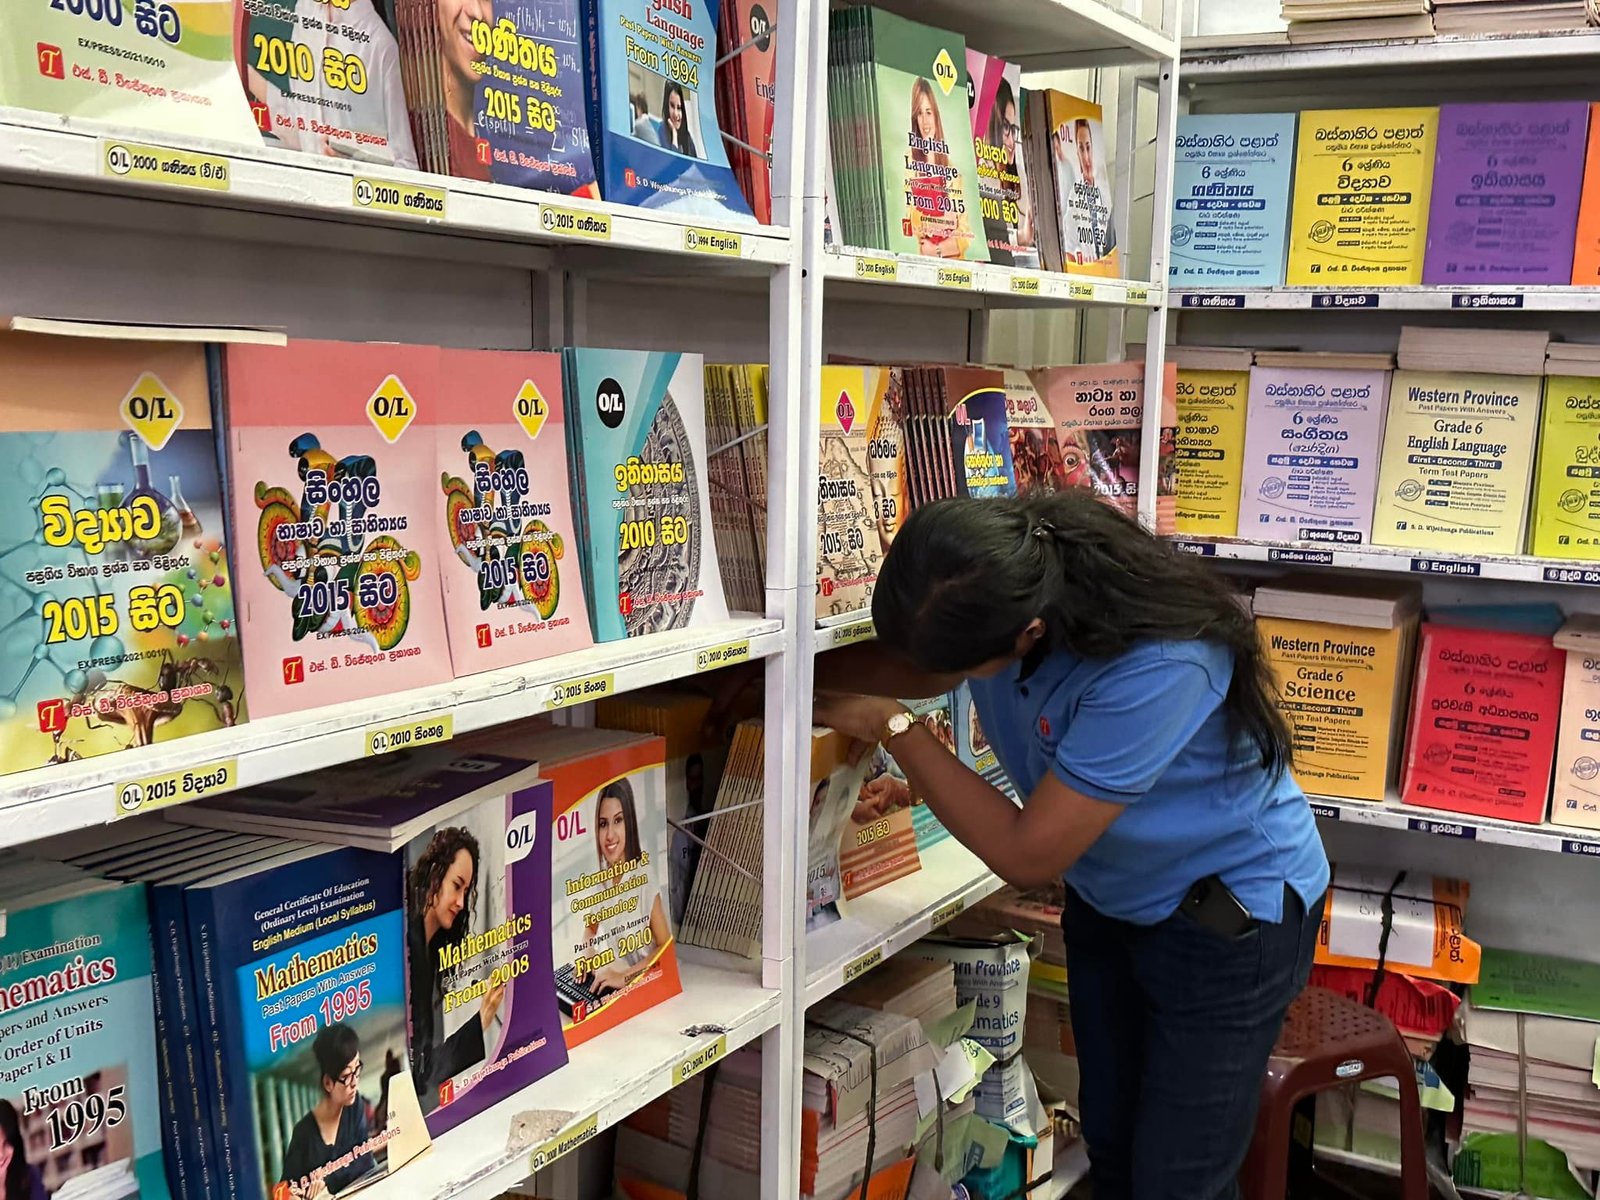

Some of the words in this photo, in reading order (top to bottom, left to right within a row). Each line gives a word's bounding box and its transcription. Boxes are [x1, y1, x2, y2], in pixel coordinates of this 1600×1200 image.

[646, 8, 704, 49] Language
[470, 18, 557, 78] ගණිතය
[254, 34, 314, 82] 2010
[323, 47, 367, 94] සිට
[626, 36, 658, 71] From
[662, 51, 698, 89] 1994
[484, 87, 521, 124] 2015
[527, 97, 556, 132] සිට
[908, 132, 949, 154] English
[1240, 133, 1279, 149] පළාත්
[1316, 126, 1378, 141] බස්නාහිර
[1383, 124, 1424, 140] පළාත්
[134, 156, 157, 171] 2000
[162, 159, 196, 176] ගණිතය
[904, 155, 958, 180] Language
[1202, 166, 1211, 178] 6
[1342, 158, 1353, 171] 6
[1191, 183, 1255, 197] ගණිතය
[1337, 175, 1391, 191] විද්‍යාව
[1471, 171, 1546, 189] ඉතිහාසය
[376, 187, 399, 204] 2010
[404, 194, 443, 211] ගණිතය
[905, 191, 934, 209] From
[938, 197, 965, 214] 2015
[557, 214, 574, 229] 2015
[577, 219, 607, 233] ගණිතය
[710, 237, 738, 250] English
[874, 264, 895, 276] English
[1203, 297, 1236, 307] ගණිතය
[1335, 296, 1366, 307] විද්‍යාව
[1472, 295, 1516, 307] ඉතිහාසය
[1075, 388, 1113, 404] නාට්‍ය
[1120, 389, 1136, 402] හා
[1200, 383, 1237, 396] පළාත්
[1265, 383, 1325, 397] බස්නාහිර
[1331, 385, 1371, 399] පළාත්
[1408, 387, 1459, 403] Western
[1463, 390, 1519, 407] Province
[129, 397, 173, 421] O/L
[373, 396, 408, 419] O/L
[518, 399, 543, 417] O/L
[598, 393, 623, 413] O/L
[1088, 405, 1115, 417] රංග
[1293, 410, 1303, 425] 6
[1434, 420, 1472, 434] Grade
[1475, 421, 1483, 434] 6
[1281, 427, 1348, 441] සංගීතය
[869, 439, 897, 459] ධර්මය
[1407, 435, 1449, 454] English
[1452, 438, 1507, 458] Language
[1412, 456, 1431, 464] First
[1437, 457, 1467, 466] Second
[1474, 459, 1496, 468] Third
[1419, 467, 1440, 476] Term
[1442, 468, 1458, 477] Test
[1460, 469, 1488, 480] Papers
[475, 462, 529, 495] සිංහල
[614, 456, 683, 492] ඉතිහාසය
[305, 470, 380, 508] සිංහල
[460, 504, 492, 524] භාෂාව
[495, 506, 507, 520] හා
[511, 501, 551, 519] සාහිත්‍යය
[40, 494, 162, 555] විද්‍යාව
[276, 519, 324, 542] භාෂාව
[329, 521, 346, 538] හා
[351, 513, 408, 535] සාහිත්‍යය
[620, 520, 656, 551] 2010
[660, 516, 688, 546] සිට
[821, 531, 841, 555] 2015
[847, 528, 864, 551] සිට
[25, 569, 63, 585] පසුගිය
[67, 563, 98, 579] විභාග
[102, 561, 129, 578] ප්‍රශ්න
[132, 560, 150, 574] සහ
[153, 554, 190, 571] පිළිතුරු
[481, 557, 516, 591] 2015
[522, 552, 550, 583] සිට
[1431, 563, 1474, 574] English
[299, 578, 350, 618] 2015
[358, 571, 398, 609] සිට
[43, 593, 119, 645] 2015
[129, 583, 186, 633] සිට
[723, 646, 748, 661] ඉතිහාසය
[1271, 635, 1319, 653] Western
[1323, 639, 1376, 657] Province
[1297, 667, 1333, 682] Grade
[1336, 670, 1343, 682] 6
[566, 684, 581, 698] 2015
[584, 679, 606, 693] සිංහල
[1285, 681, 1355, 701] Science
[1302, 704, 1331, 713] Second
[1337, 706, 1357, 716] Third
[1324, 715, 1350, 726] Papers
[390, 730, 411, 747] 2010
[414, 723, 444, 741] සිංහල
[146, 779, 176, 802] 2015
[182, 768, 228, 793] විද්‍යාව
[506, 824, 533, 849] O/L
[557, 811, 587, 841] O/L
[857, 827, 875, 847] 2015
[565, 857, 638, 896] Information
[640, 850, 650, 867] &
[255, 904, 283, 921] General
[284, 892, 322, 911] Certificate
[323, 886, 332, 897] Of
[334, 877, 370, 895] Education
[570, 873, 648, 913] Communication
[261, 914, 295, 933] (Ordinary
[297, 904, 319, 921] Level)
[320, 890, 365, 911] Examination
[584, 895, 638, 928] Technology
[252, 932, 282, 952] English
[283, 921, 314, 940] Medium
[315, 912, 339, 931] (Local
[340, 899, 376, 921] Syllabus)
[574, 941, 588, 954] Past
[589, 931, 610, 949] Papers
[611, 924, 625, 938] With
[627, 914, 650, 931] Answers
[22, 934, 101, 964] Examination
[438, 912, 532, 973] Mathematics
[483, 954, 499, 968] With
[500, 940, 529, 960] Answers
[574, 948, 615, 978] From
[618, 927, 652, 959] 2010
[255, 932, 377, 1002] Mathematics
[975, 957, 1020, 977] Province
[262, 1001, 284, 1018] Past
[285, 988, 315, 1010] Papers
[316, 978, 337, 994] With
[338, 963, 376, 985] Answers
[443, 979, 489, 1014] From
[491, 954, 530, 988] 2008
[26, 1010, 48, 1030] and
[53, 994, 109, 1019] Answers
[992, 995, 1000, 1009] 9
[269, 1012, 317, 1052] From
[319, 979, 373, 1027] 1995
[4, 1037, 43, 1061] Order
[48, 1027, 62, 1046] of
[65, 1018, 103, 1039] Units
[705, 1043, 719, 1062] ICT
[23, 1074, 84, 1115] From
[47, 1085, 125, 1152] 1995
[558, 1125, 598, 1156] Mathematics
